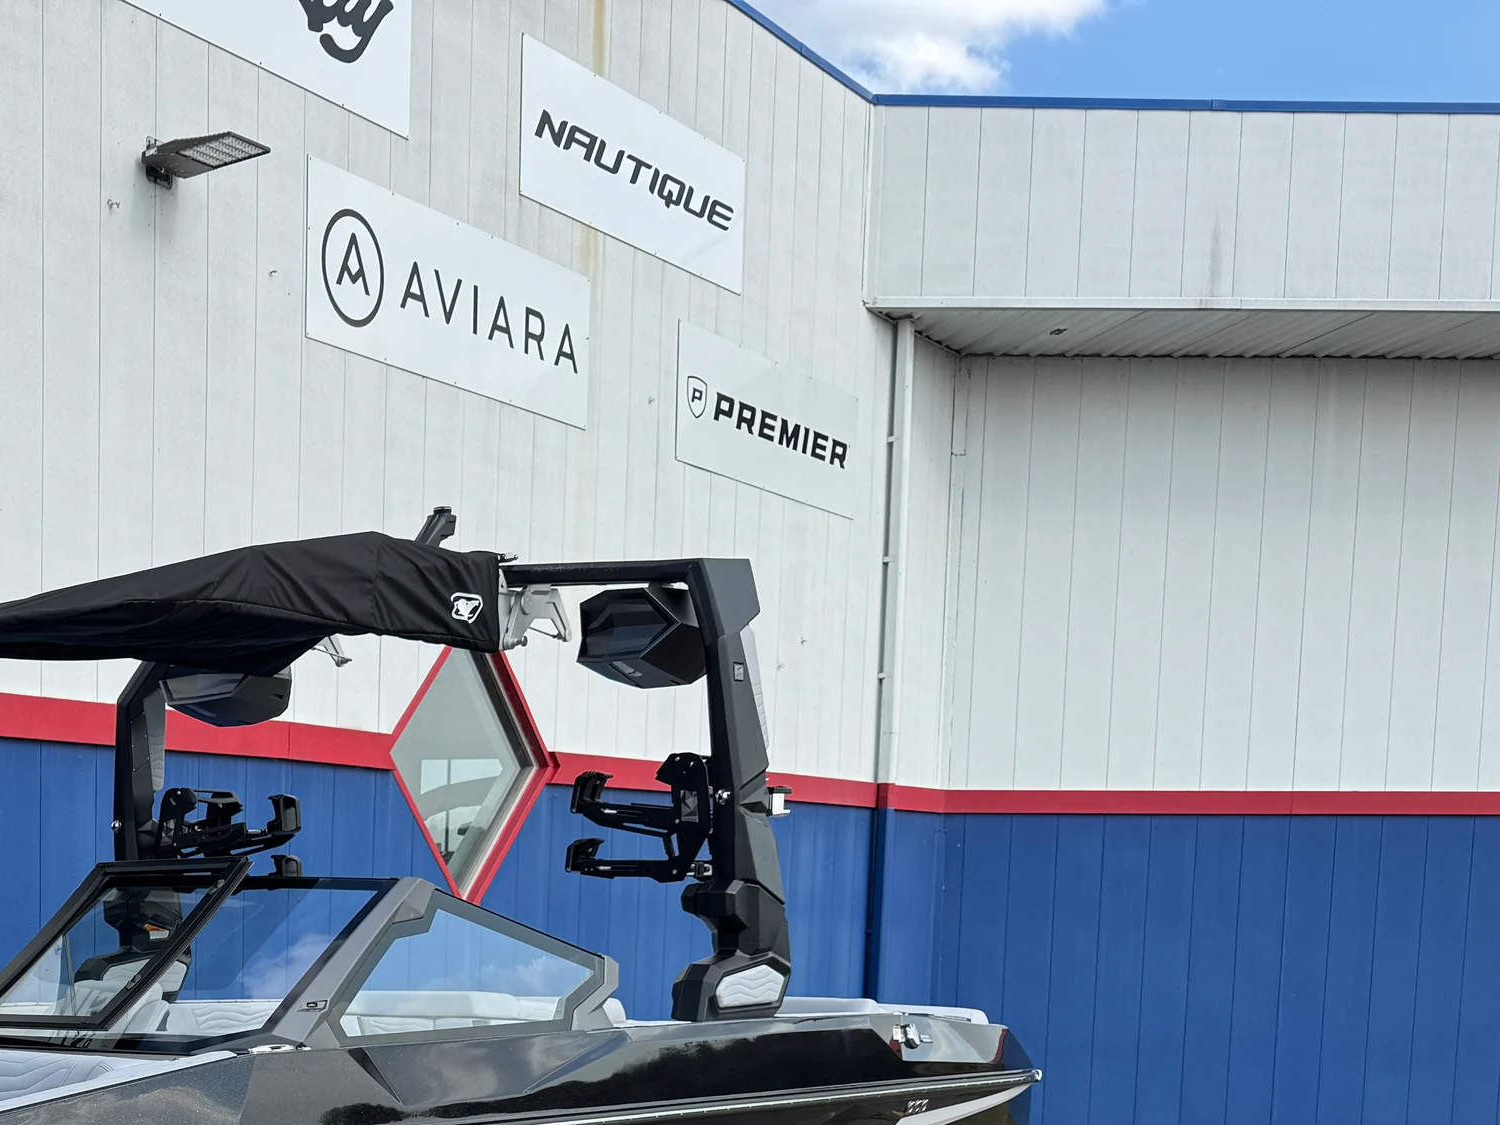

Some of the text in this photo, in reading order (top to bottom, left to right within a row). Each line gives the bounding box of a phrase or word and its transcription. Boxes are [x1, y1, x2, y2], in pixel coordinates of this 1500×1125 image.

[534, 108, 735, 232] NAUTIQUE
[399, 260, 579, 375] AVIARA
[713, 391, 848, 470] PREMIER
